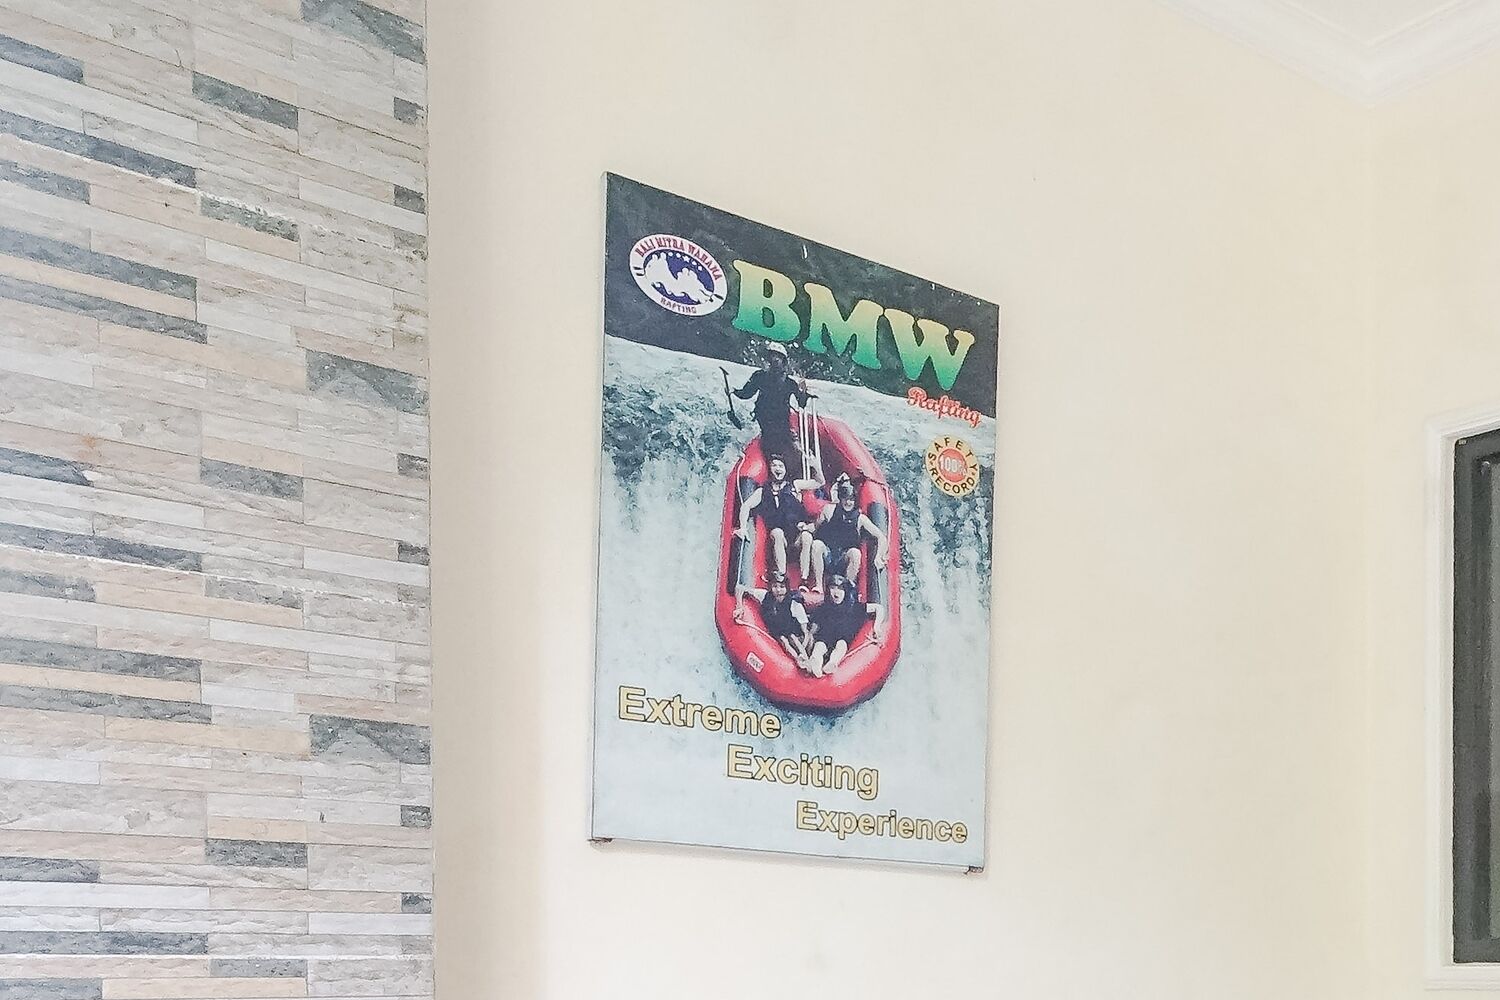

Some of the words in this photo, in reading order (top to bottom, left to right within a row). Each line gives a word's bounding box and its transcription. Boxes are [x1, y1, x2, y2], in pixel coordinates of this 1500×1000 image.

[660, 297, 697, 314] RAFTING
[732, 259, 976, 391] BMW
[907, 386, 982, 428] Rafting
[928, 437, 978, 472] SAFETY
[939, 456, 967, 476] 100%
[929, 468, 975, 494] RECORD
[618, 685, 781, 738] Extreme
[726, 744, 879, 800] Exciting
[796, 801, 968, 843] Experience
